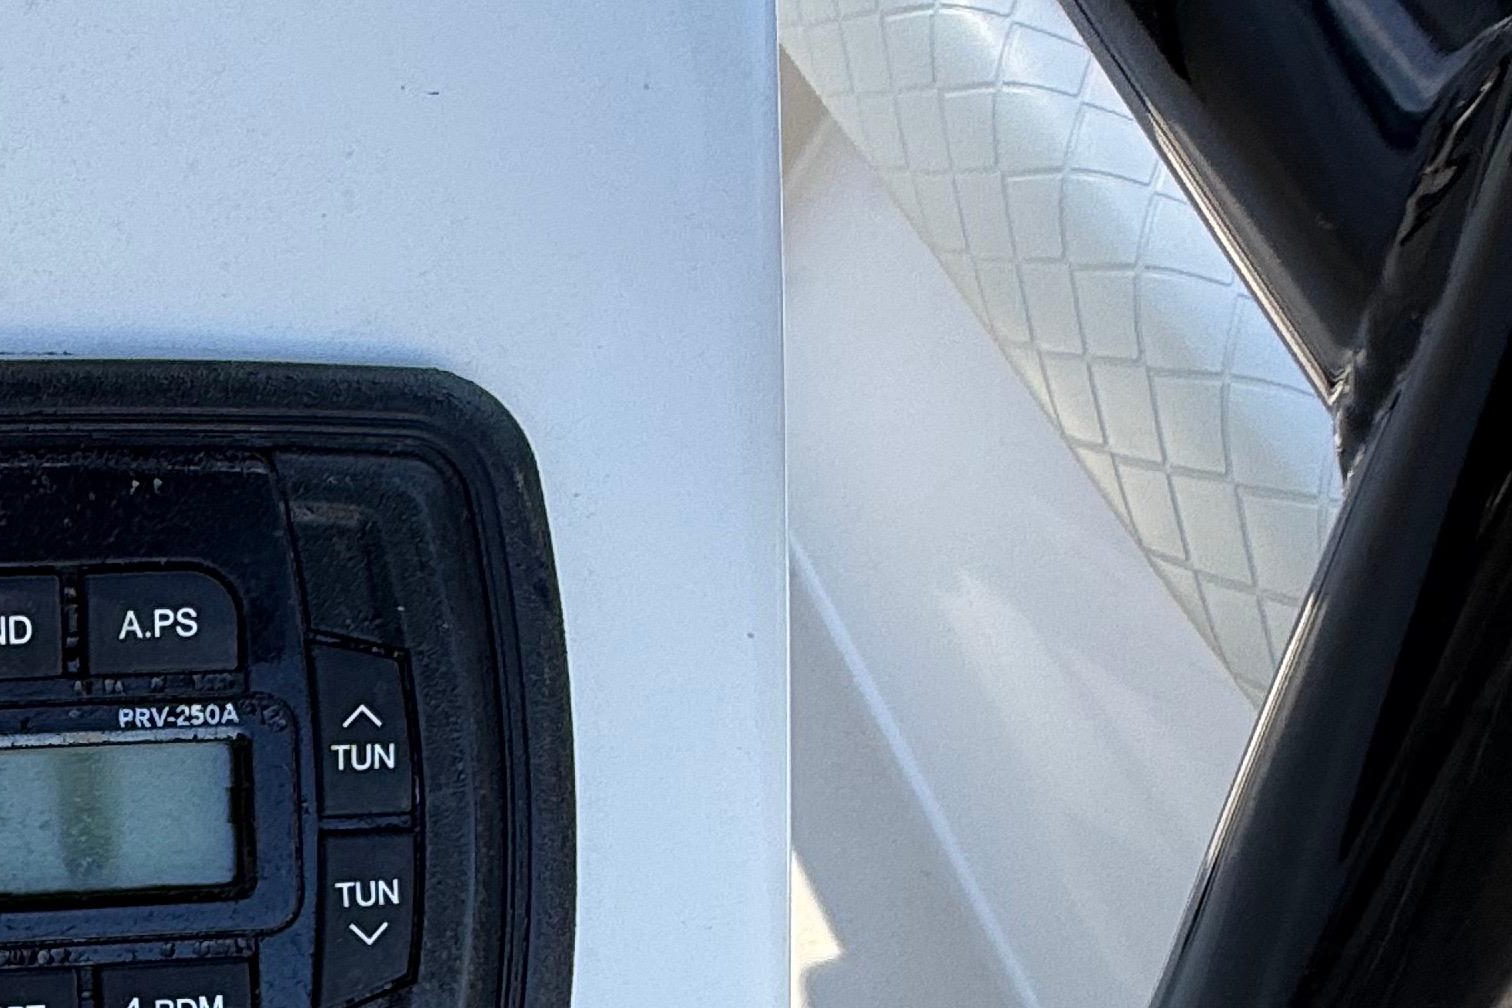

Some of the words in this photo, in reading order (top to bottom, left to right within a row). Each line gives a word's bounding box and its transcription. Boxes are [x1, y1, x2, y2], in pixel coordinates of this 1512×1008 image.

[118, 608, 198, 640] A.PS
[118, 703, 239, 728] PRV-250A
[331, 743, 396, 771] TUN
[335, 879, 400, 907] TUN
